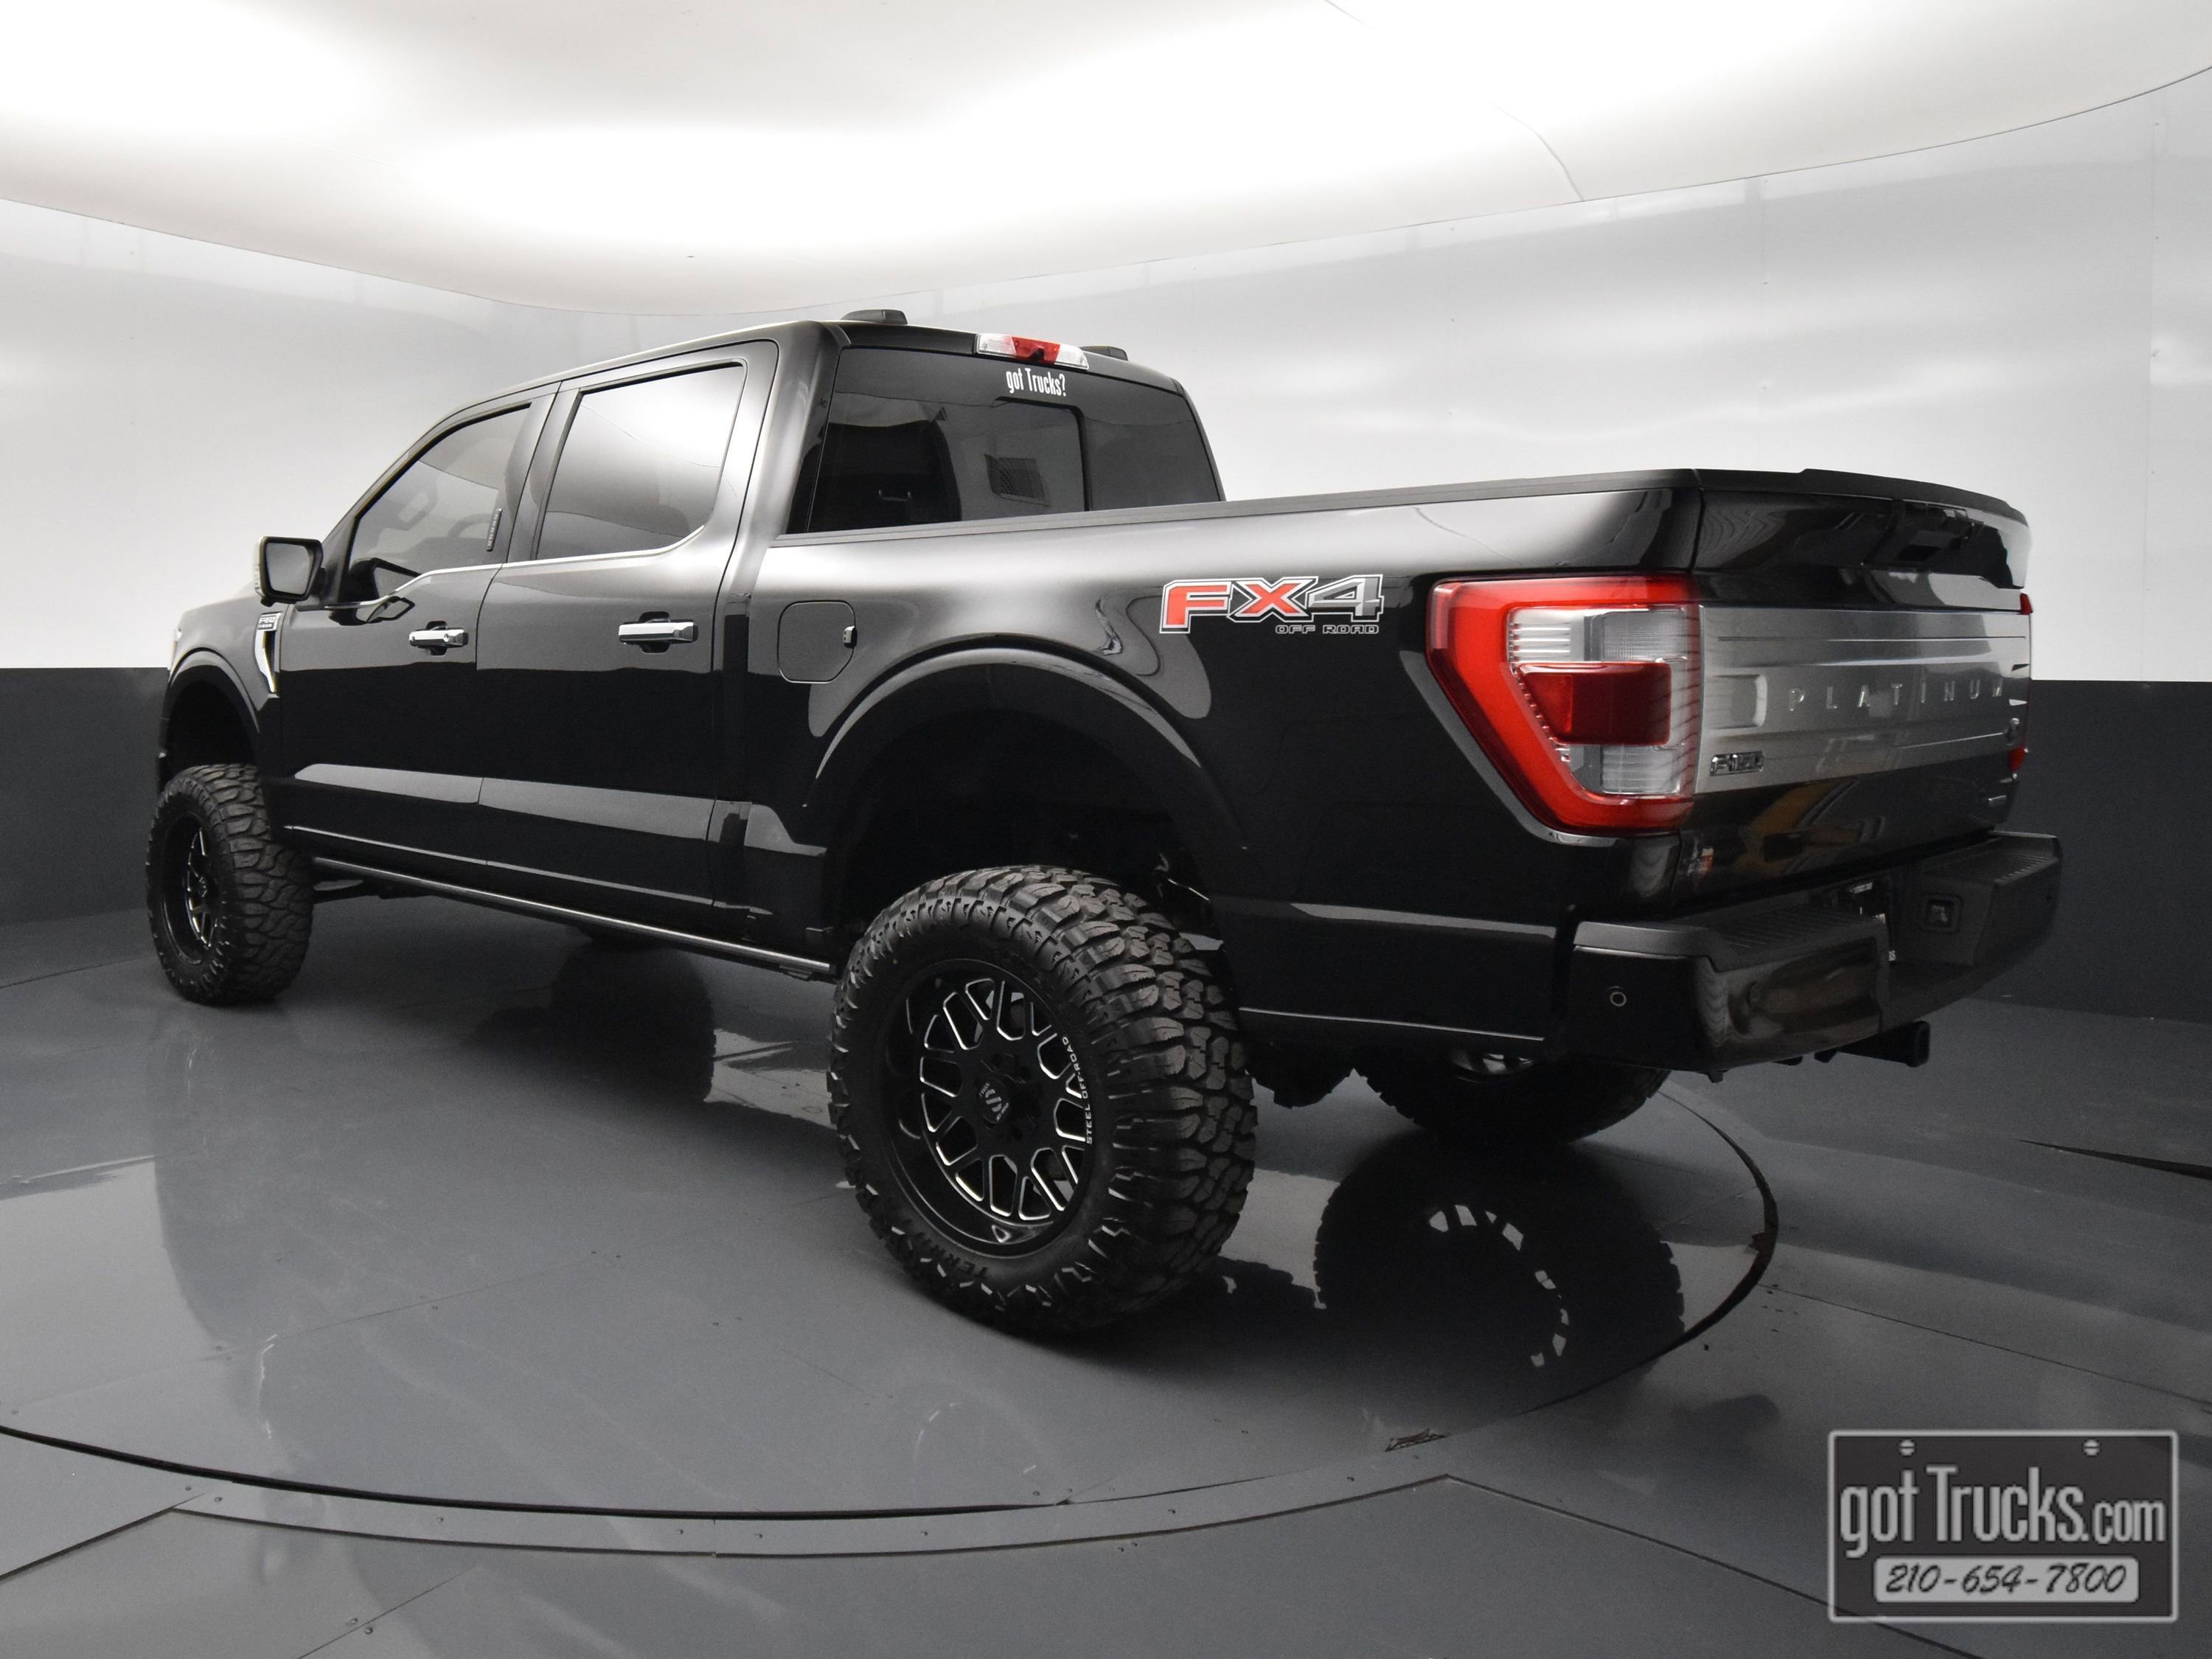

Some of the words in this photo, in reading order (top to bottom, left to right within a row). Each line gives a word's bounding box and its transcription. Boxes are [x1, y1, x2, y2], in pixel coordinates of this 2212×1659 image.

[1006, 368, 1024, 394] got
[1024, 367, 1066, 397] Trucks?
[1159, 574, 1385, 634] FX4
[1275, 625, 1316, 634] OFF
[1321, 625, 1380, 634] ROAD
[1062, 1037, 1088, 1099] OFF-ROAD
[1084, 1103, 1093, 1144] STEEL
